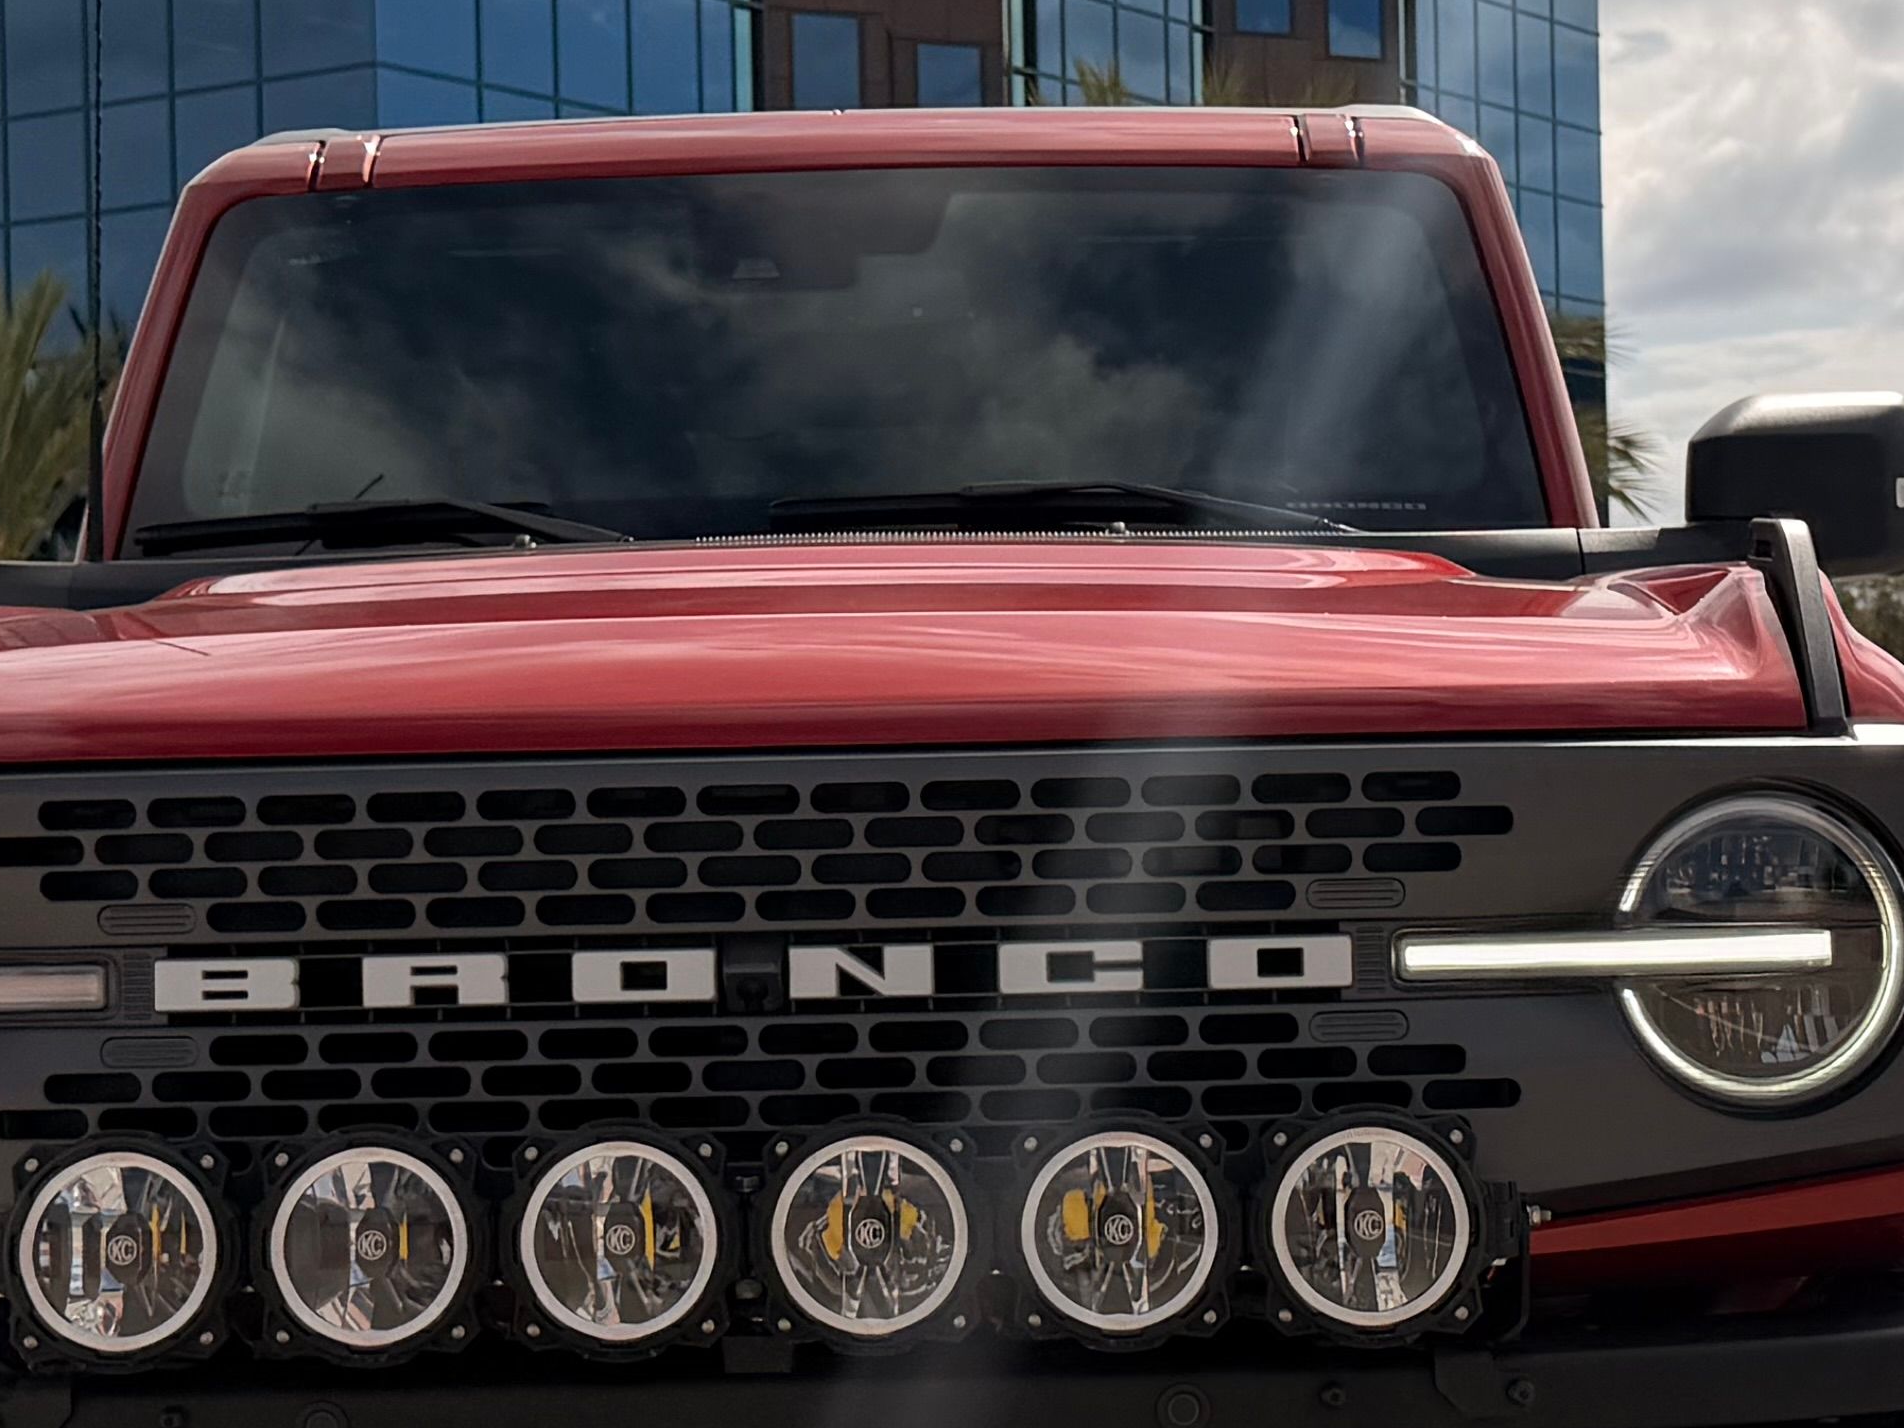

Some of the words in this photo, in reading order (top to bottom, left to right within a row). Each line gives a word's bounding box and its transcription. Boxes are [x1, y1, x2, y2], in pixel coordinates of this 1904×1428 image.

[154, 933, 1353, 1012] BRONCO
[859, 1222, 881, 1246] KC
[1107, 1217, 1130, 1242] KC
[1358, 1213, 1381, 1237] KC
[111, 1238, 133, 1262] KC
[361, 1233, 383, 1258] KC
[610, 1227, 632, 1252] KC
